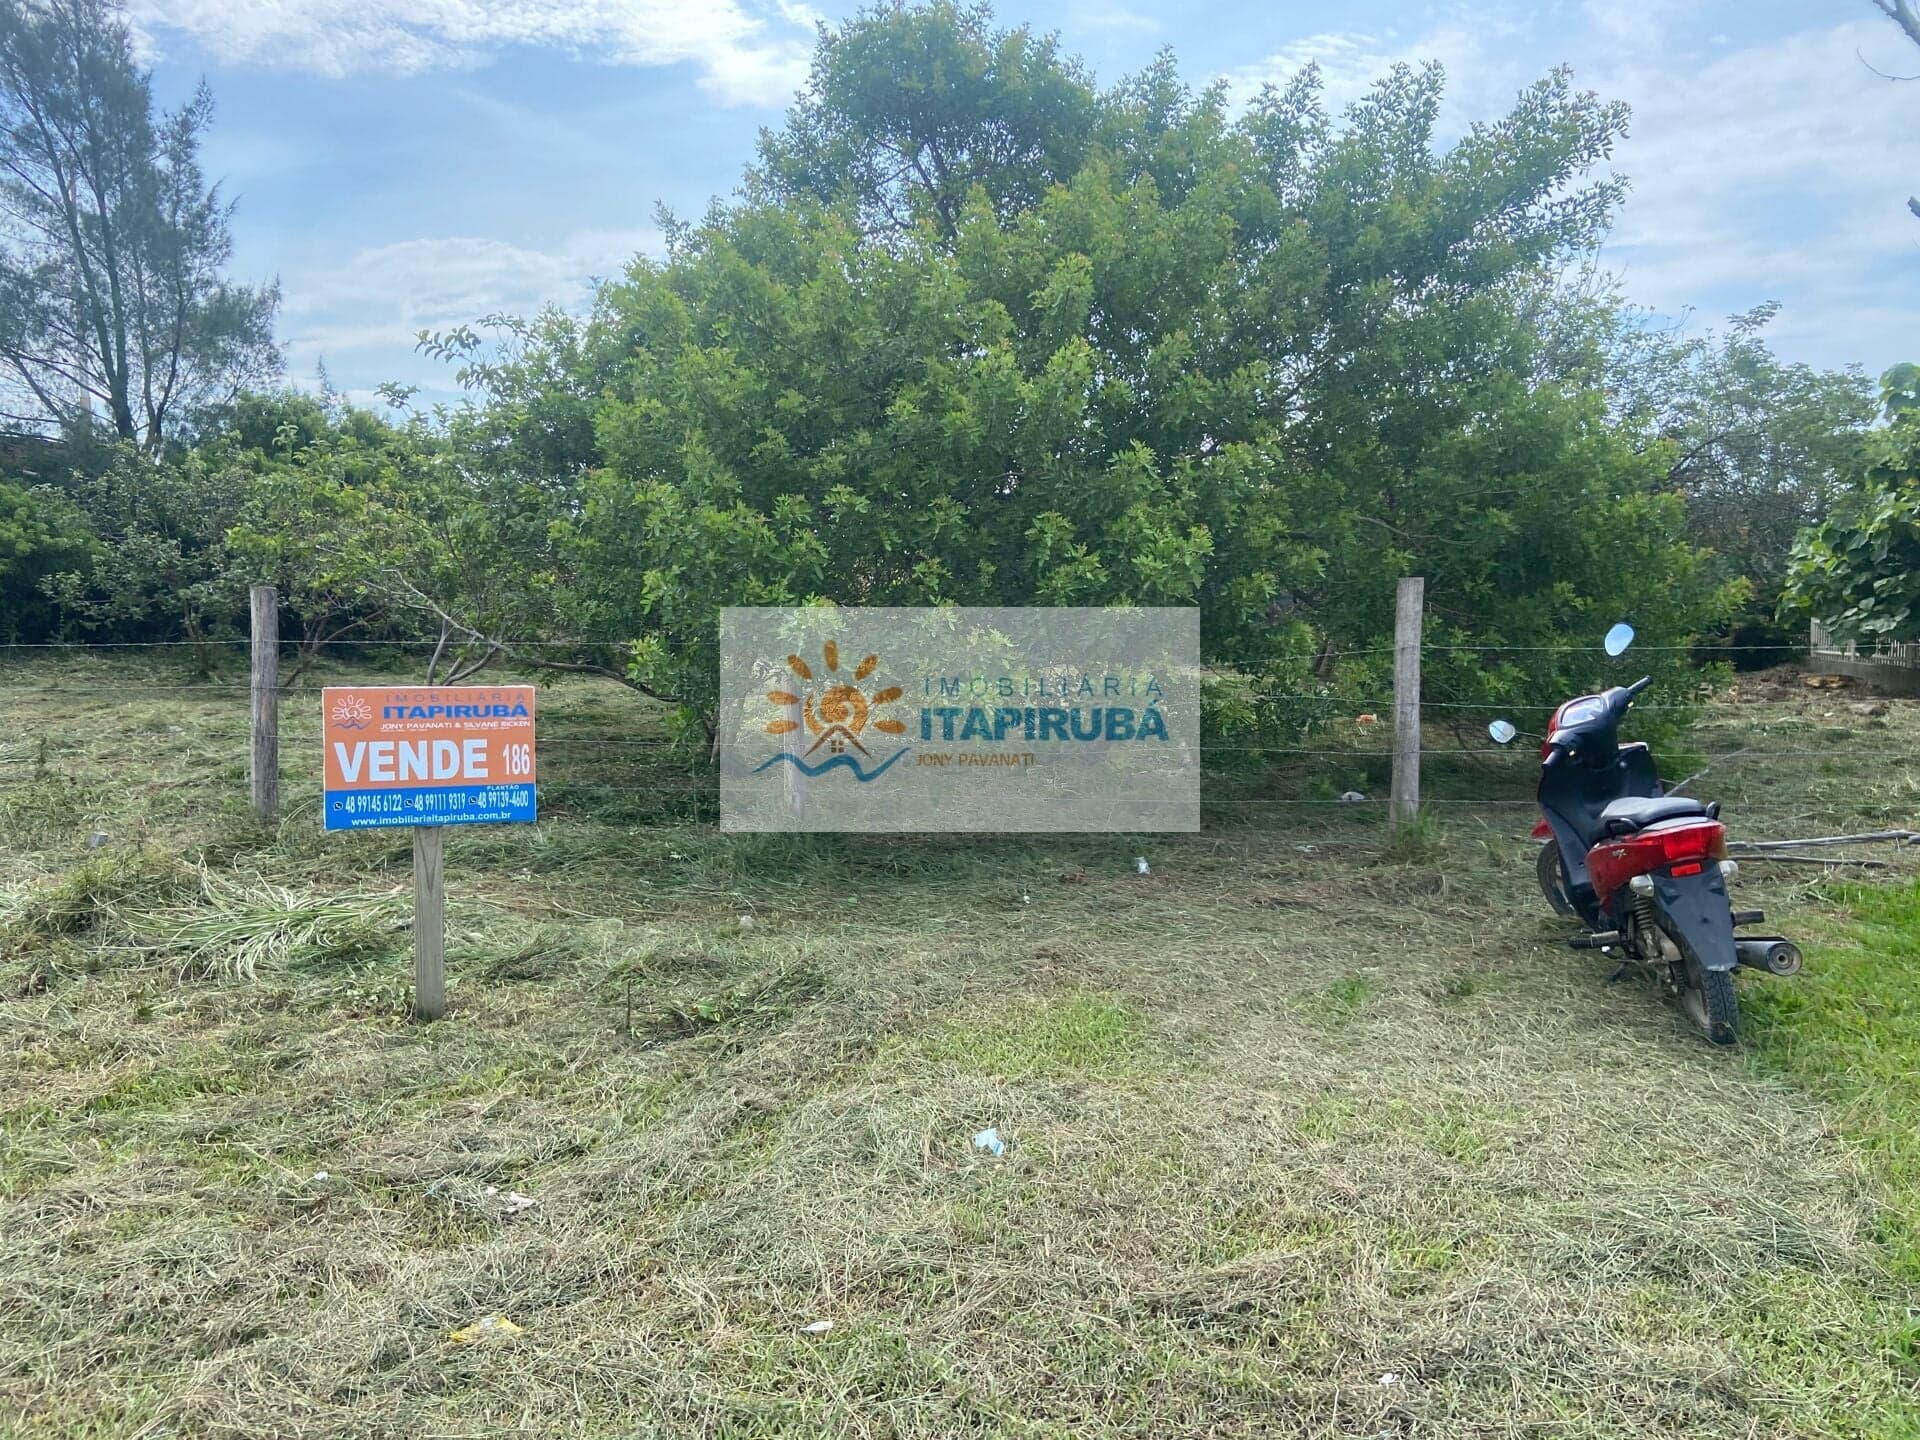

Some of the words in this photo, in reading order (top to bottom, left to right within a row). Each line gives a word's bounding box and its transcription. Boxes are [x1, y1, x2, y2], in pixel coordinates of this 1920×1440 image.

[383, 702, 529, 719] ITAPIRUBÁ
[380, 722, 404, 730] JONY
[407, 721, 452, 729] PAVANATI
[463, 721, 499, 729] SILVANE
[333, 738, 489, 783] VENDE
[502, 743, 530, 775] 186
[345, 797, 355, 813] 48
[357, 795, 382, 812] 99145
[383, 794, 402, 812] 6122
[414, 795, 424, 812] 48
[425, 793, 447, 811] 99111
[448, 792, 466, 810] 9319
[477, 791, 487, 809] 48
[351, 811, 512, 826] www.imobiliariaitapiruba.com.br
